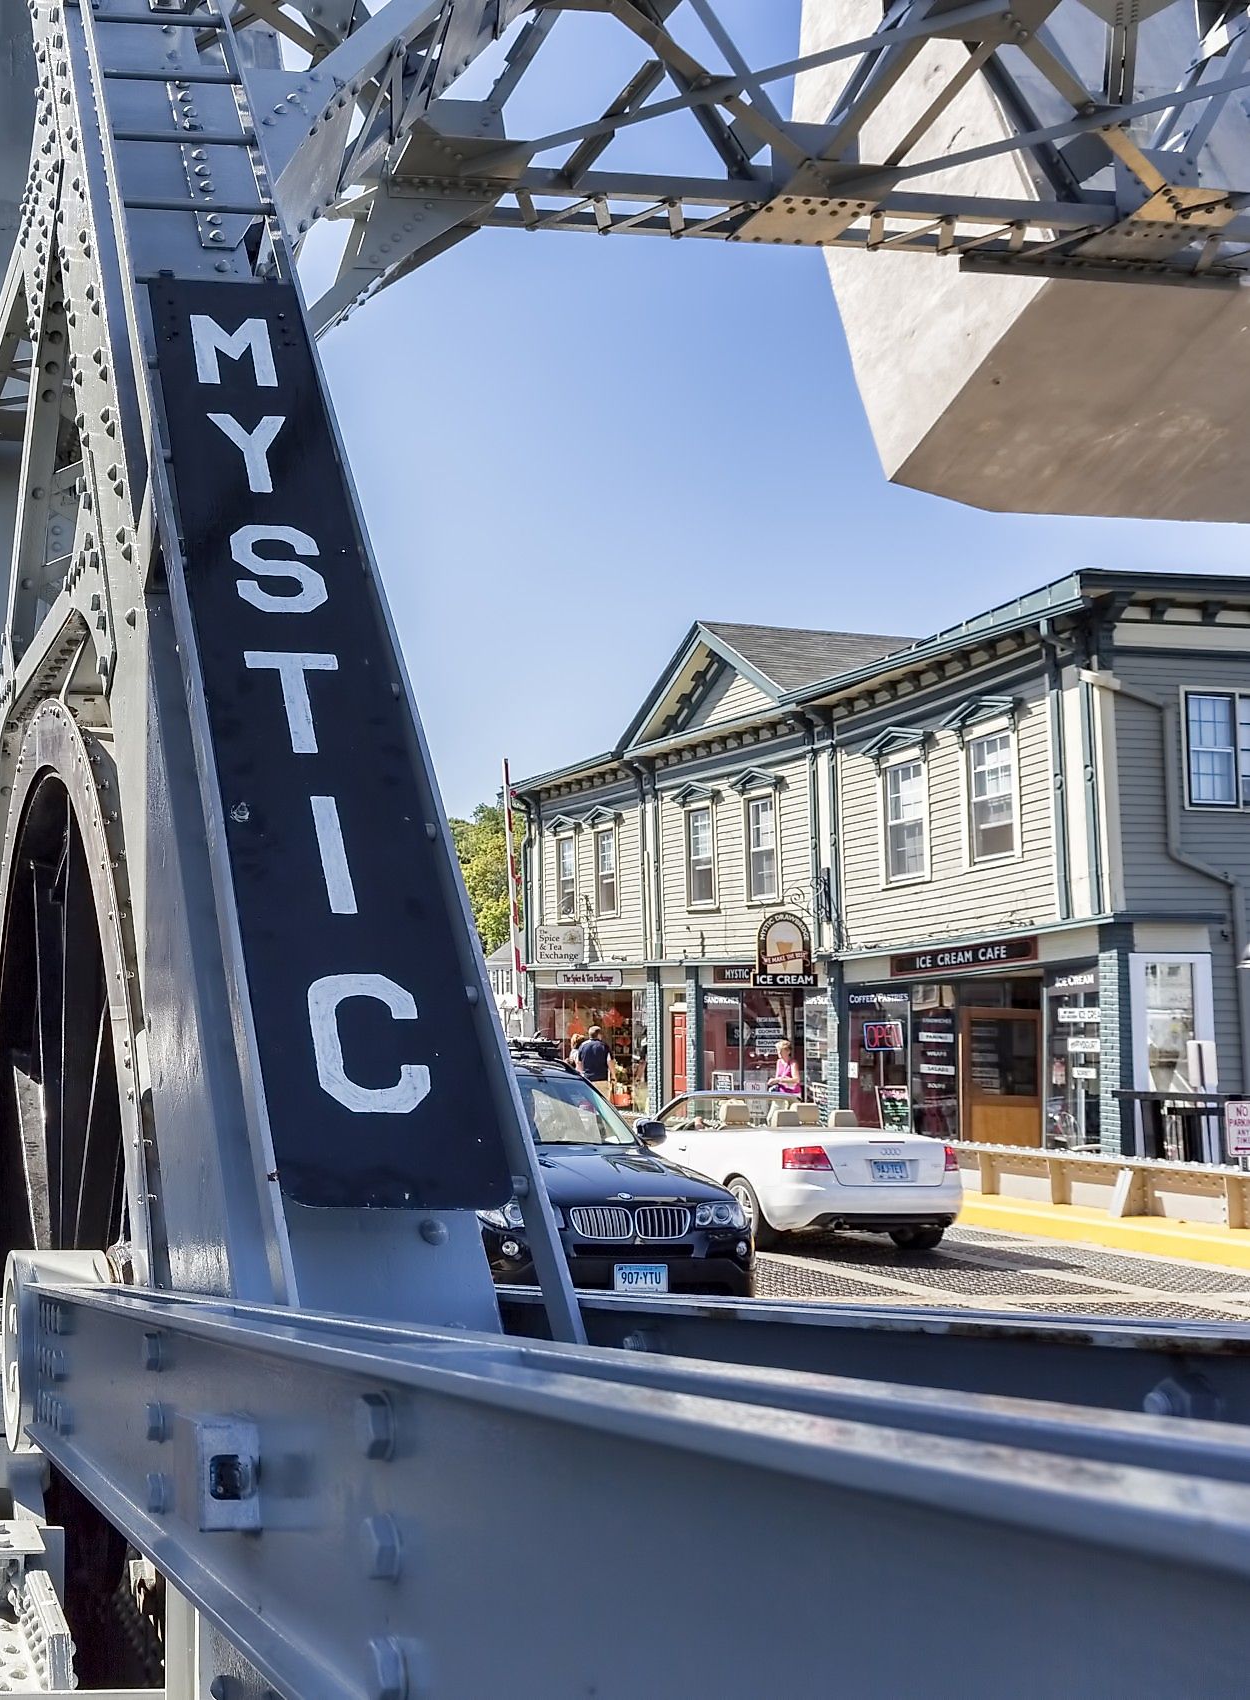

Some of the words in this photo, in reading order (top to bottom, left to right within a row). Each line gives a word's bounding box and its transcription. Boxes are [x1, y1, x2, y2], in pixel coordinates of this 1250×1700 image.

[190, 313, 433, 1114] MYSTIC
[759, 917, 775, 940] MYSTIC
[774, 913, 810, 940] DRAWBRIDGE
[539, 934, 560, 944] Spice
[539, 951, 579, 961] Exchange
[916, 955, 932, 969] ICE
[937, 950, 973, 966] CREAM
[978, 945, 1007, 961] CAFE
[725, 968, 749, 979] MYSTIC
[756, 975, 773, 985] ICE
[776, 974, 814, 985] CREAM
[1068, 974, 1095, 986] CREAM
[866, 1024, 902, 1048] OPEN
[1236, 1106, 1249, 1117] NO
